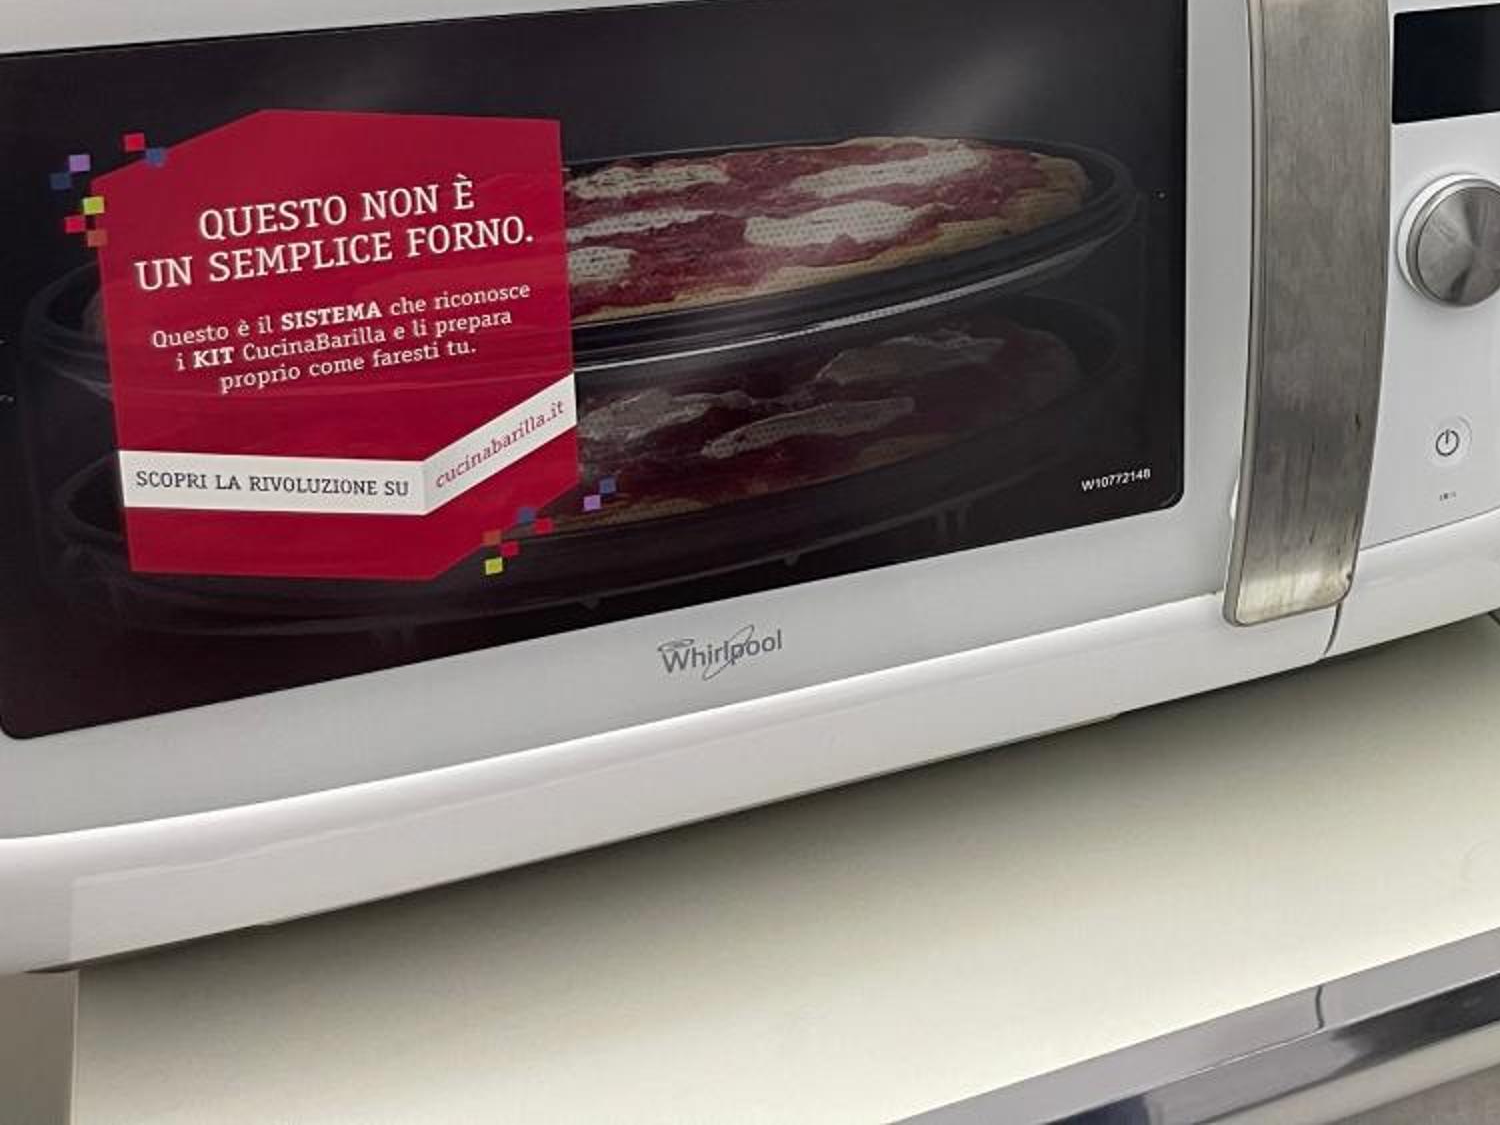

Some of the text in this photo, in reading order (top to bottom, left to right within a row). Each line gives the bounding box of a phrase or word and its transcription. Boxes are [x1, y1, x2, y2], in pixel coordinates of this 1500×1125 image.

[200, 173, 475, 240] QUESTO NON È
[134, 216, 533, 291] UN SEMPLICE FORNO.
[152, 284, 530, 348] Questo è il SISTEMA che riconosce
[176, 353, 186, 371] i
[193, 347, 235, 368] KIT
[243, 326, 386, 361] CucinaBarilla
[393, 327, 405, 340] e
[435, 310, 512, 338] prepara
[220, 340, 477, 394] proprio come faresti tu.
[436, 400, 564, 488] cucinabarilla.it
[136, 470, 409, 497] SCOPRI LA RIVOLUZIONE SU
[658, 627, 782, 676] Whirlpool
